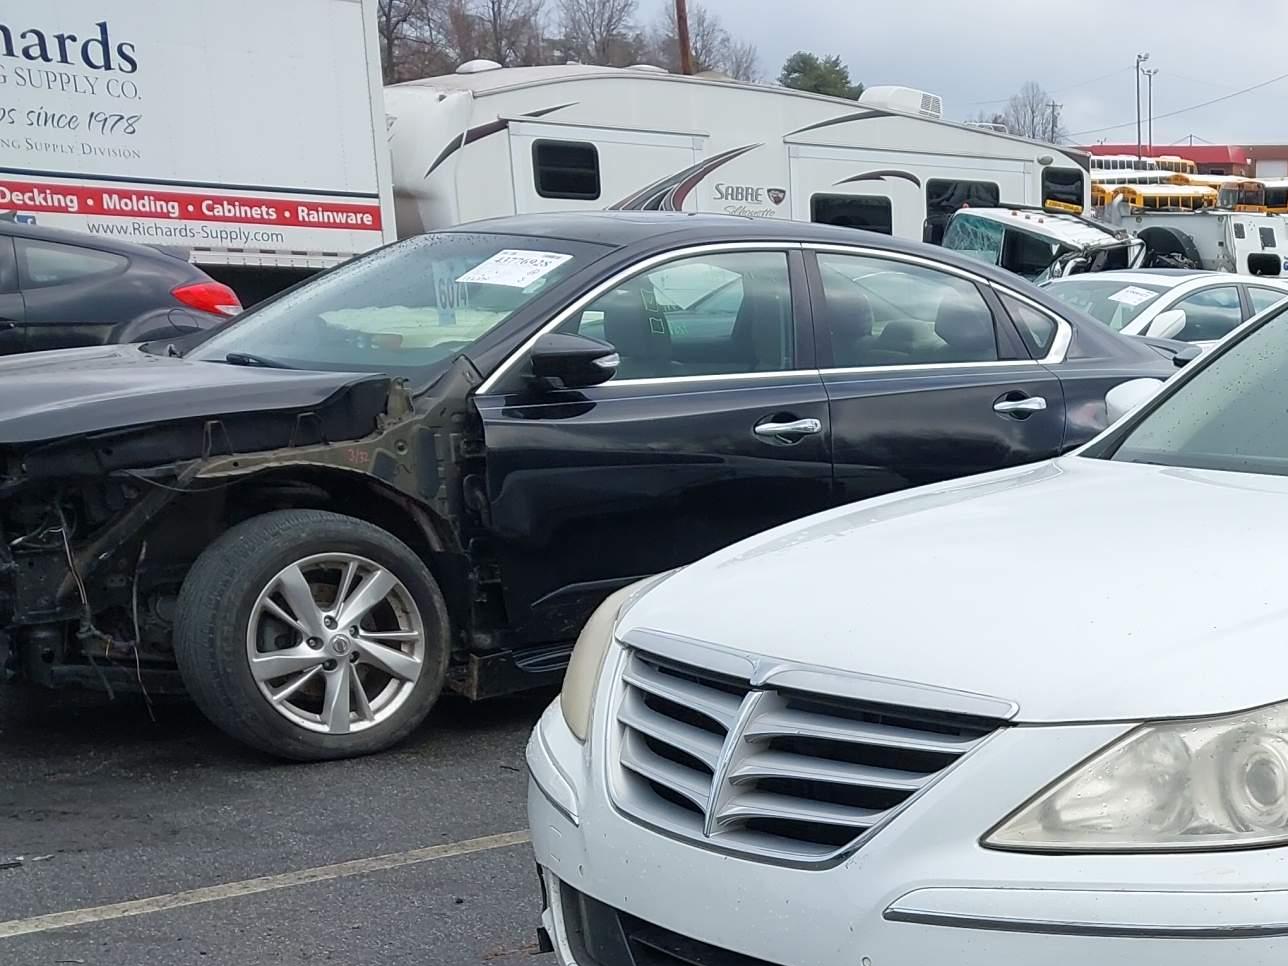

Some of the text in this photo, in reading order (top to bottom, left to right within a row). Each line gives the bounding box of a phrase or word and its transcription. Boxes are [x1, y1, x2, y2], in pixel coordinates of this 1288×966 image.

[14, 66, 99, 95] SUPPLY
[106, 78, 143, 100] CO.
[26, 106, 80, 130] since
[88, 111, 143, 136] 1978
[0, 187, 373, 225] Decking Molding Cabinets Rainware
[713, 183, 764, 202] SABRE
[87, 222, 284, 244] www.Richards-Supply.com
